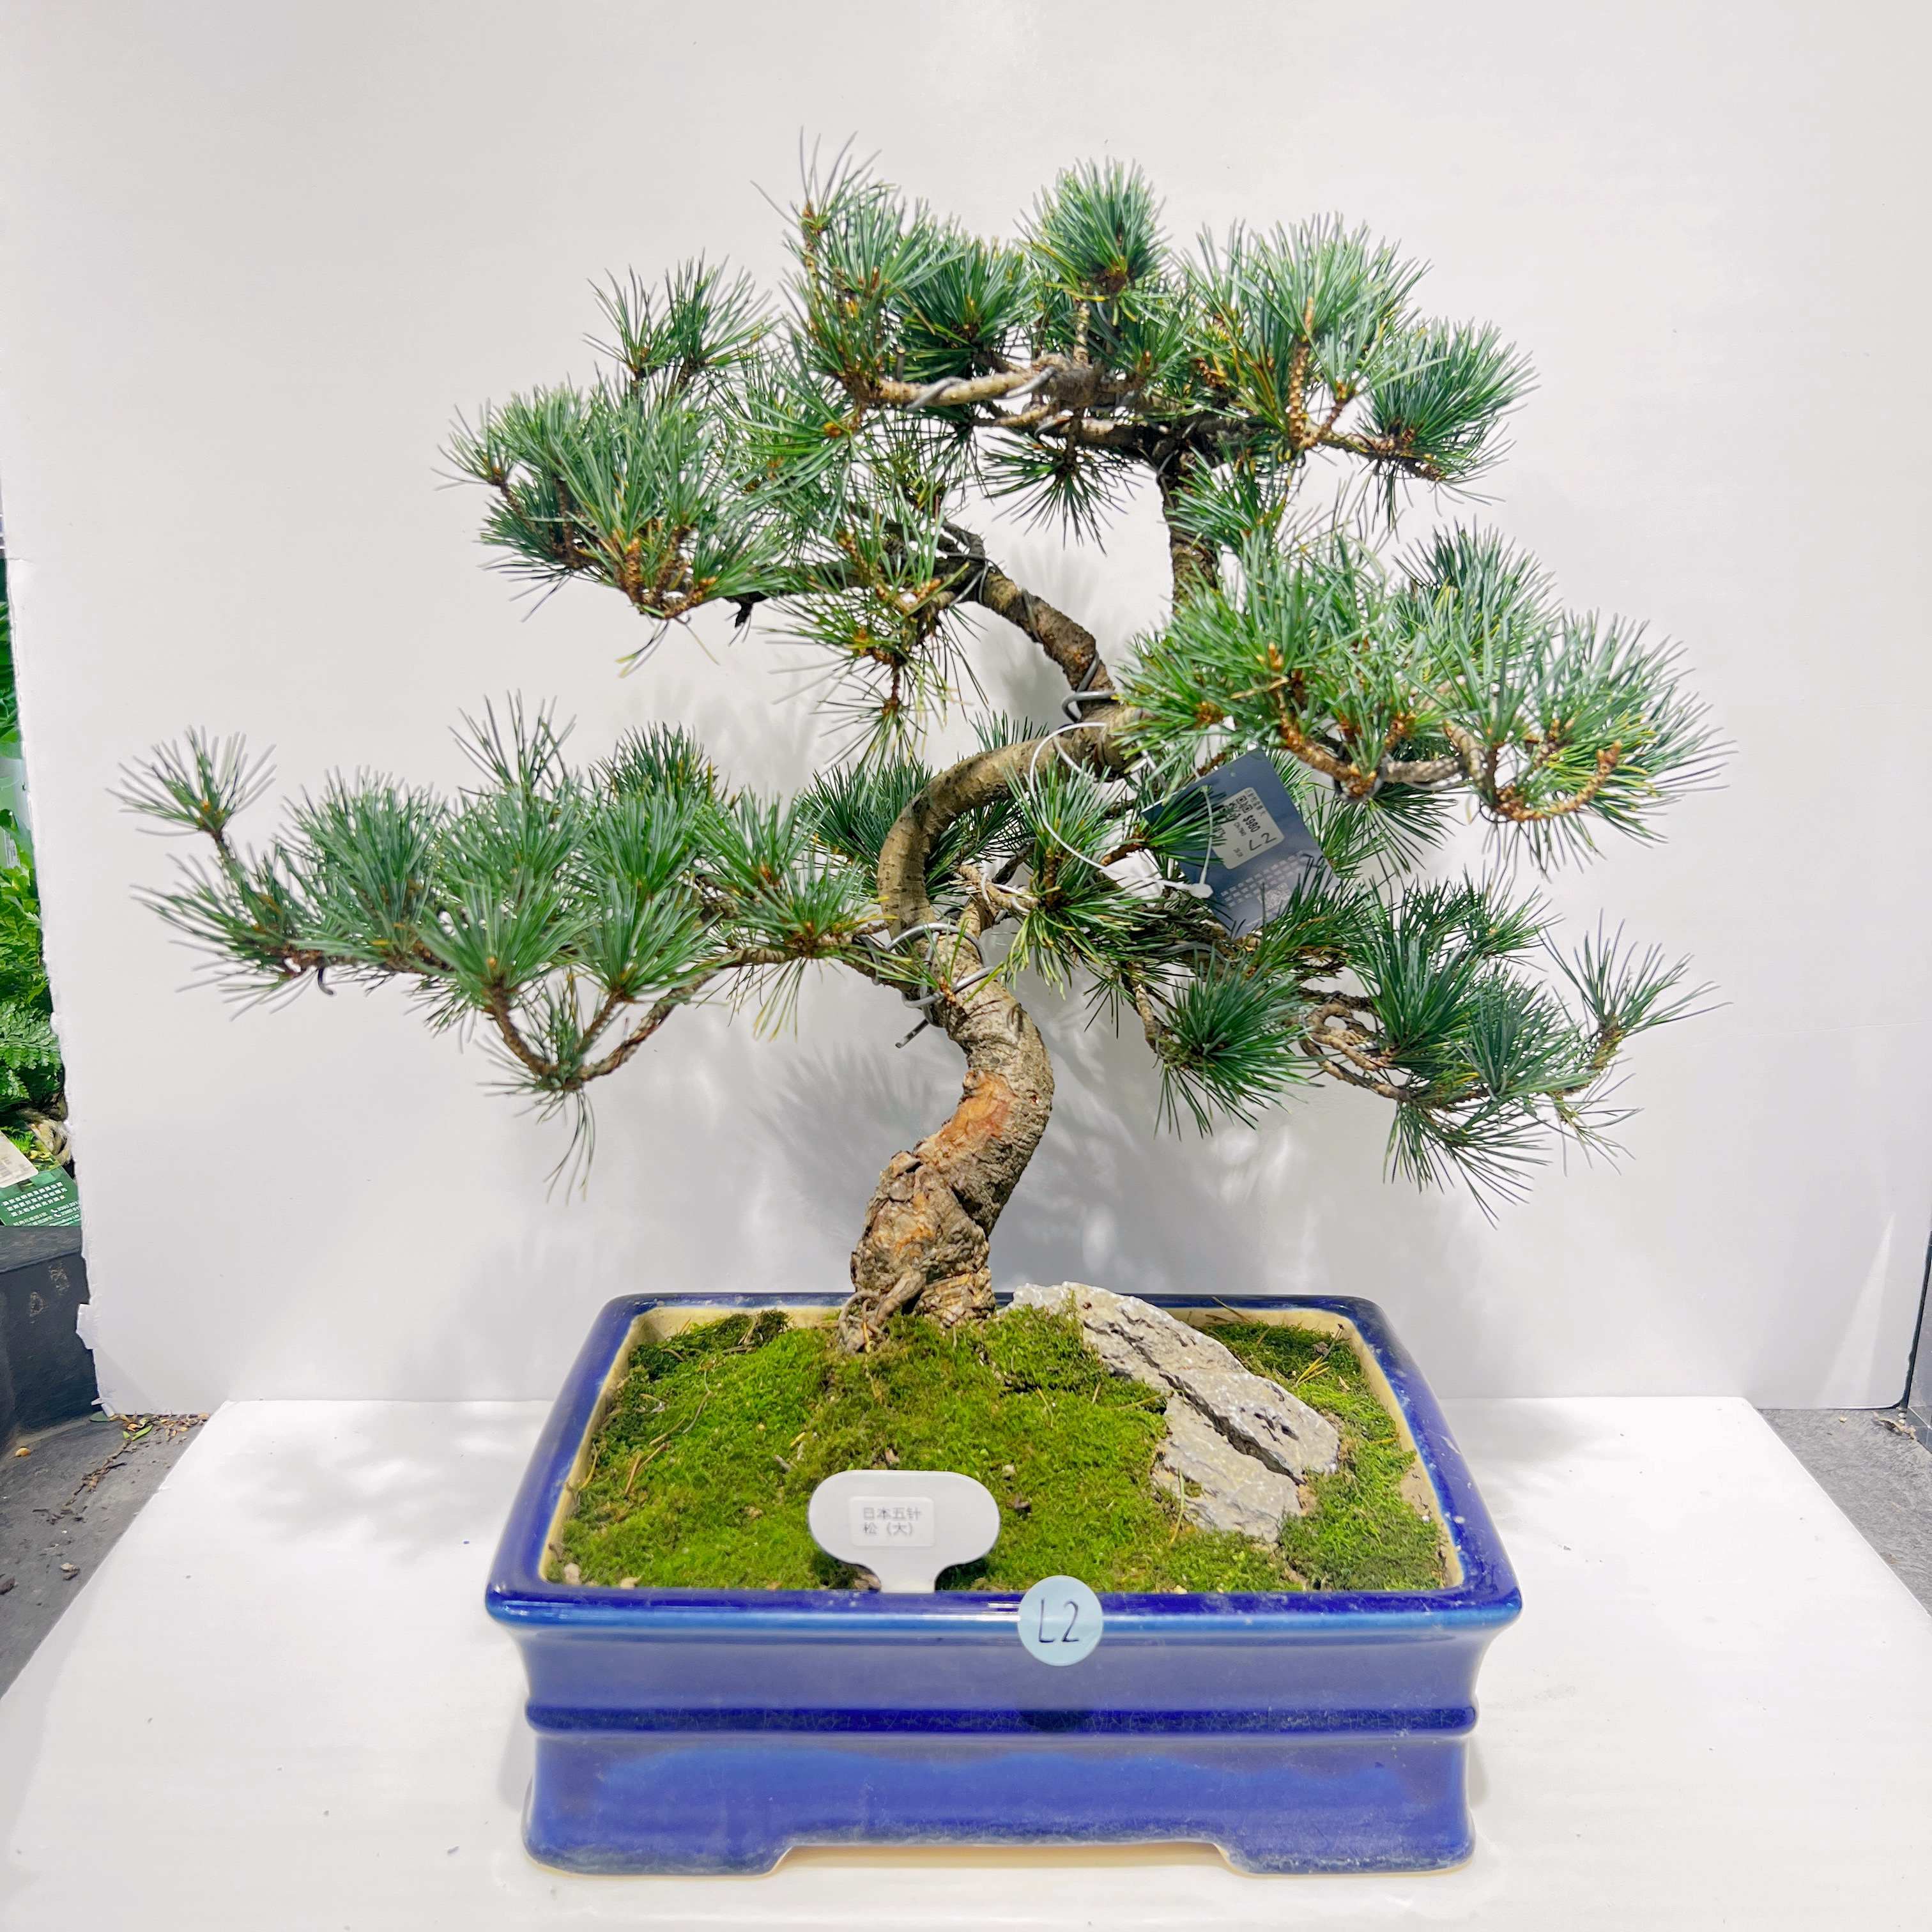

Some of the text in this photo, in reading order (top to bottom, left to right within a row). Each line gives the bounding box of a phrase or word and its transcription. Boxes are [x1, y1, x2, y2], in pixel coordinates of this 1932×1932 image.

[1242, 815, 1261, 833] $980
[1248, 832, 1277, 852] L2
[862, 1506, 921, 1521] 日本五针
[1038, 1598, 1080, 1643] L2
